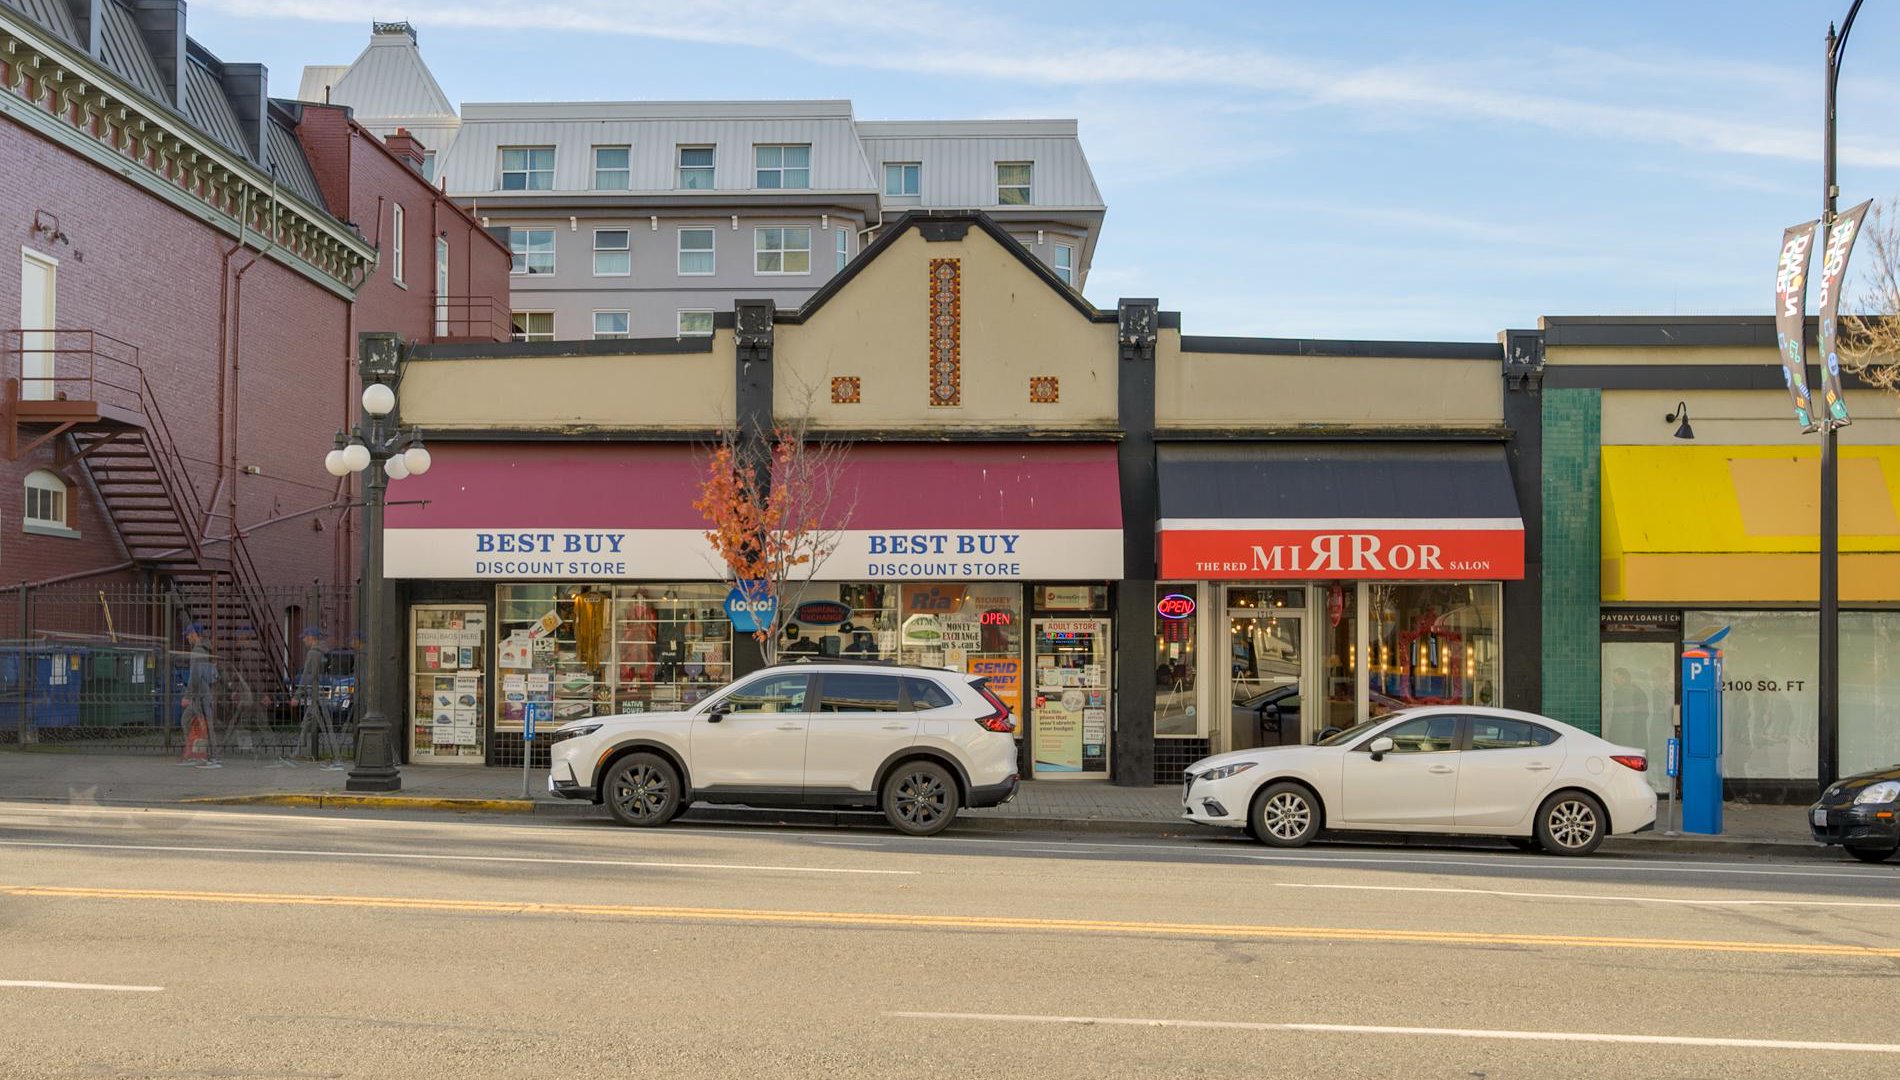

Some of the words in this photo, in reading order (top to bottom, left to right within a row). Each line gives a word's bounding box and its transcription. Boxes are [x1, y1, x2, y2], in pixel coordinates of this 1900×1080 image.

[476, 533, 554, 553] BEST
[563, 534, 625, 553] BUY
[868, 535, 947, 554] BEST
[956, 535, 1019, 554] BUY
[476, 562, 564, 574] DISCOUNT
[569, 562, 625, 574] STORE
[868, 563, 957, 576] DISCOUNT
[963, 563, 1020, 576] STORE
[1196, 562, 1222, 571] THE
[1223, 562, 1247, 571] RED
[1450, 561, 1490, 570] SALON
[911, 587, 951, 609] Ria
[1159, 600, 1193, 613] OPEN
[980, 612, 1010, 625] OPEN
[946, 622, 970, 631] MONEY
[942, 632, 979, 640] EXCHANGE
[974, 662, 1017, 674] SEND
[1691, 662, 1702, 681] P
[991, 675, 1016, 684] NEY
[1758, 681, 1781, 692] SQ.
[1787, 681, 1805, 691] FT
